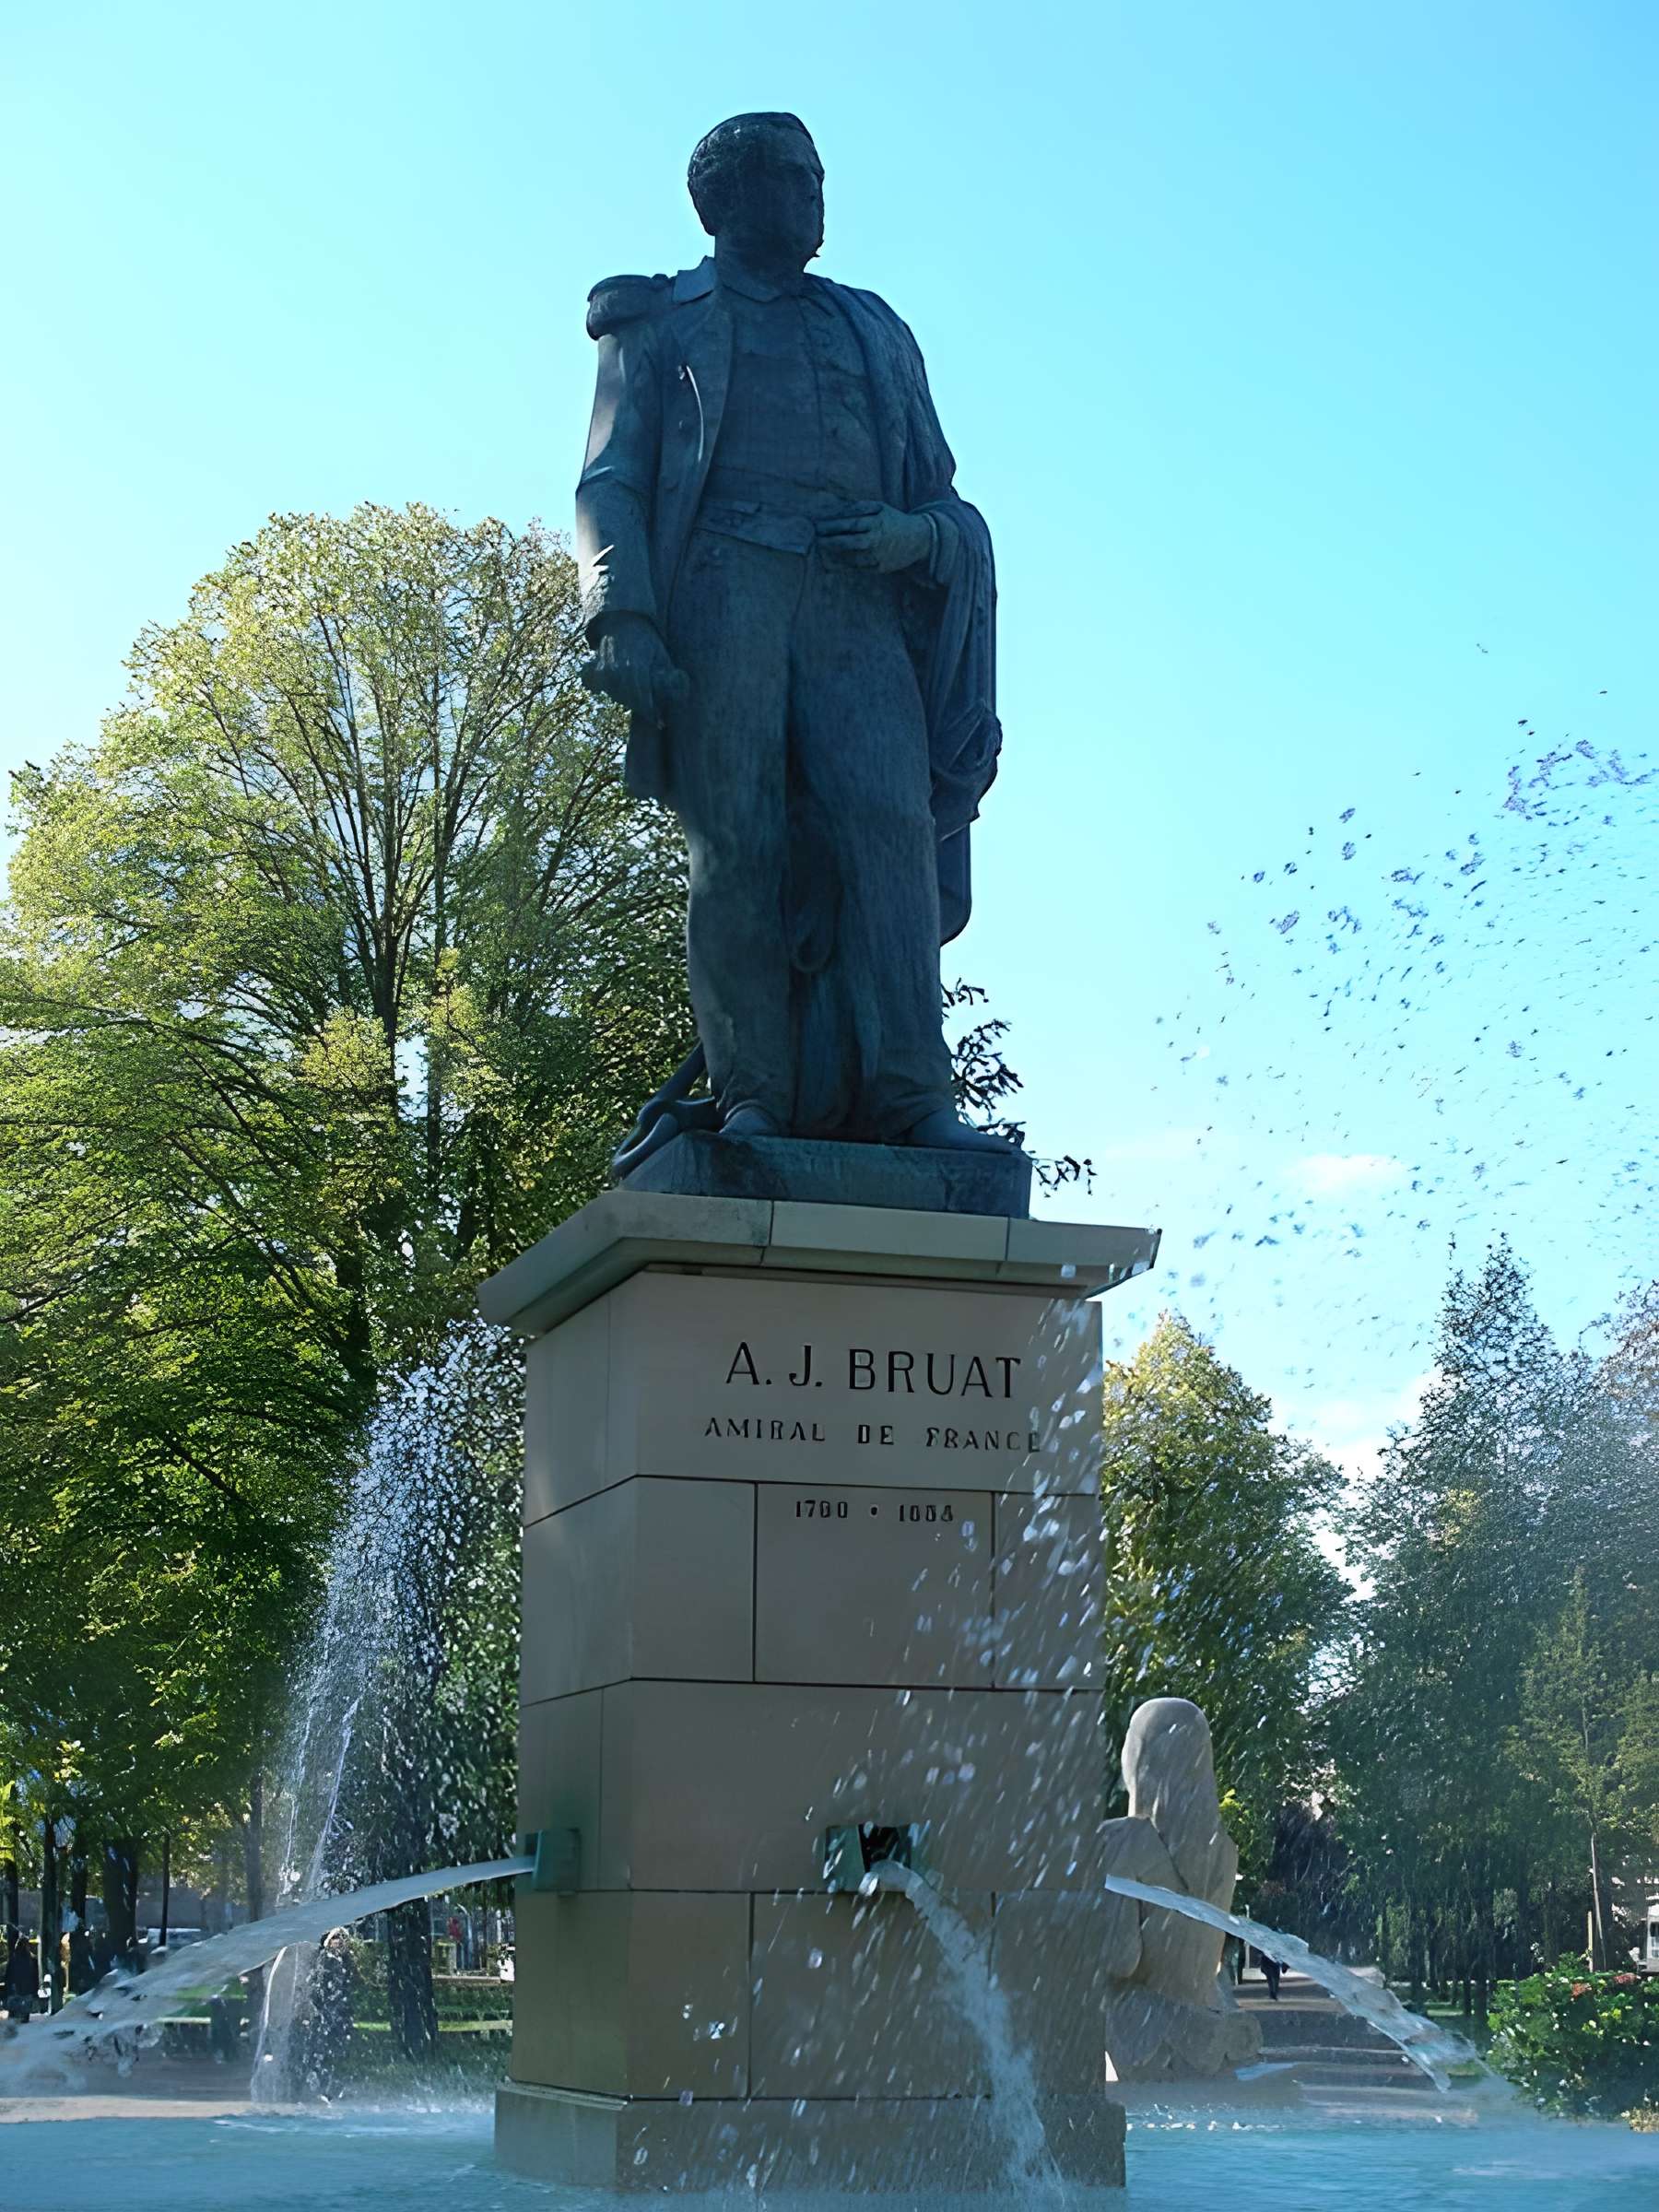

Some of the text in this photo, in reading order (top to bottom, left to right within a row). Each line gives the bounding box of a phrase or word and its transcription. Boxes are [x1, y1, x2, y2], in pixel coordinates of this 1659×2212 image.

[848, 1347, 1021, 1398] BRUAT
[704, 1417, 1041, 1453] AMIRAL DE FRANCE
